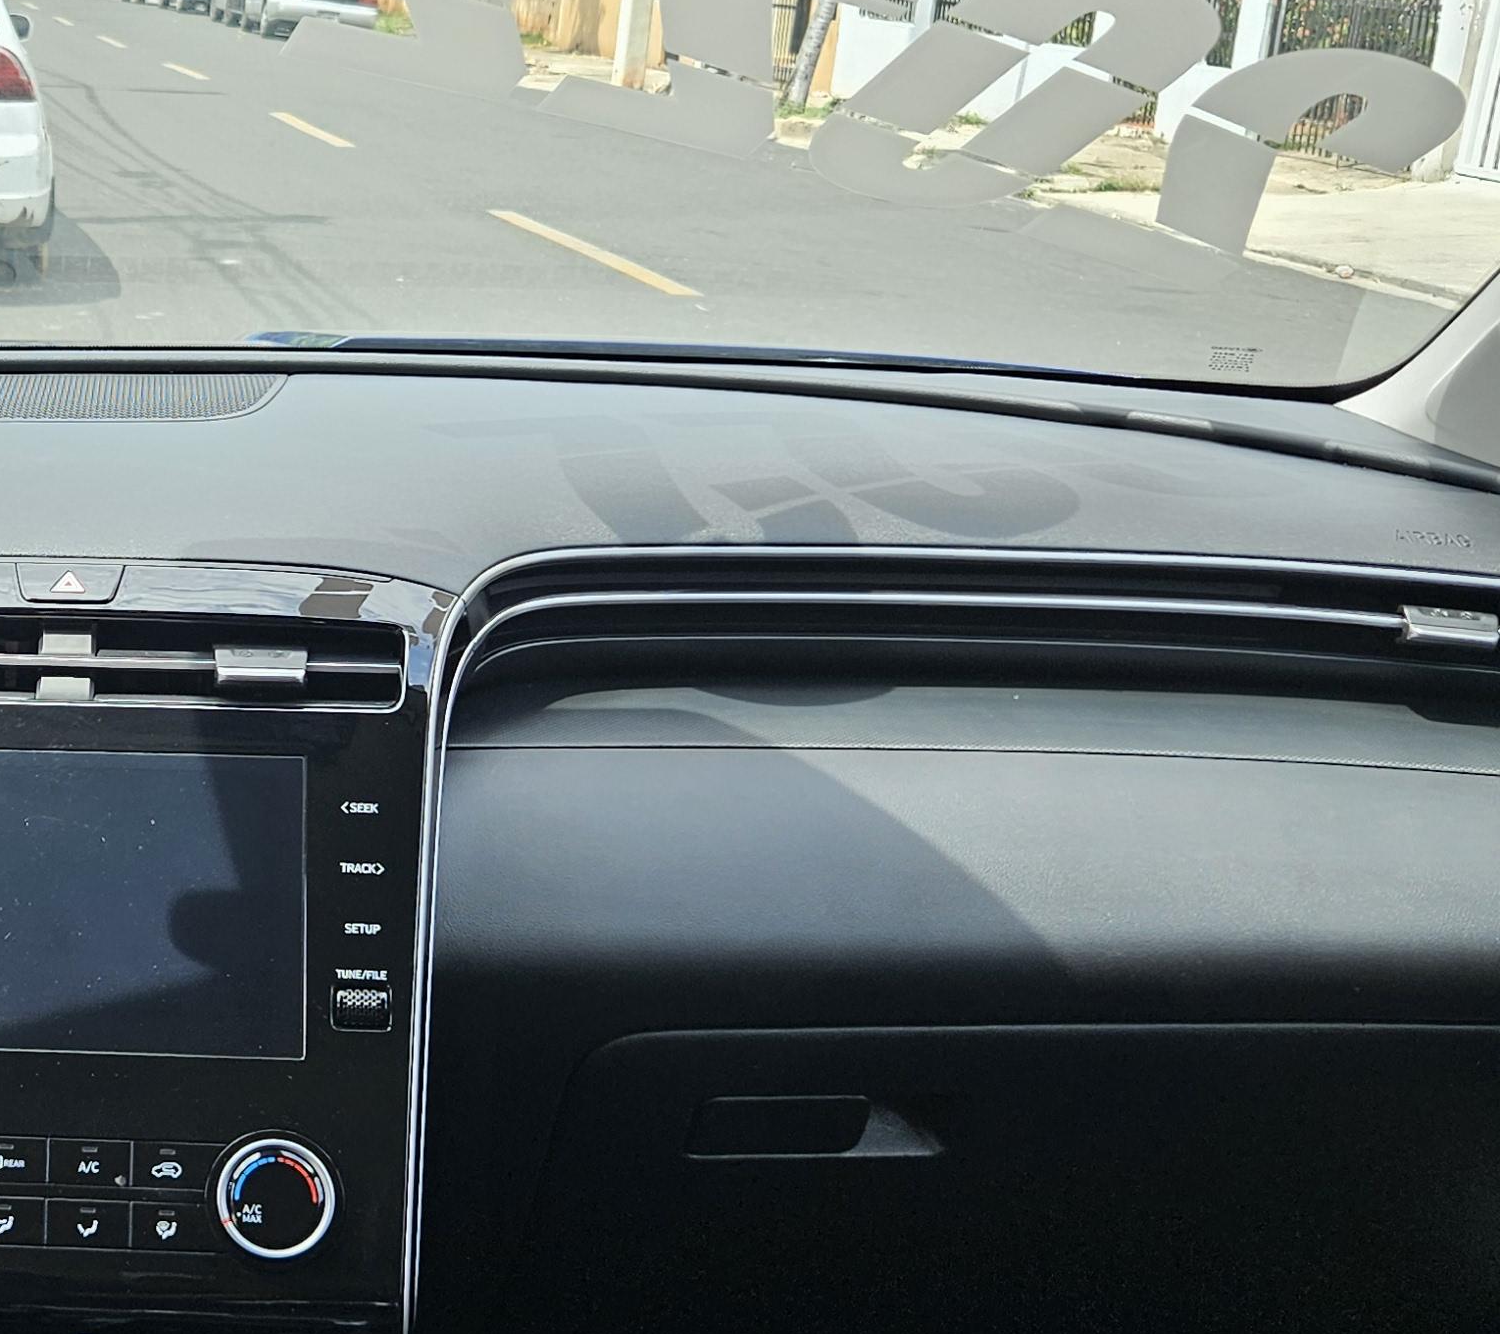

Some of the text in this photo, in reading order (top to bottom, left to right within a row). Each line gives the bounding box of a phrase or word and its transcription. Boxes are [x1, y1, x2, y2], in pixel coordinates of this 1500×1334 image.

[350, 802, 379, 814] SEEK
[340, 862, 377, 874] TRACK
[344, 923, 382, 935] SETUP
[335, 969, 388, 981] TUNE/FILE
[3, 1158, 25, 1168] REAR
[78, 1160, 100, 1174] A/C
[242, 1204, 262, 1215] A/C
[242, 1214, 262, 1223] MAX
